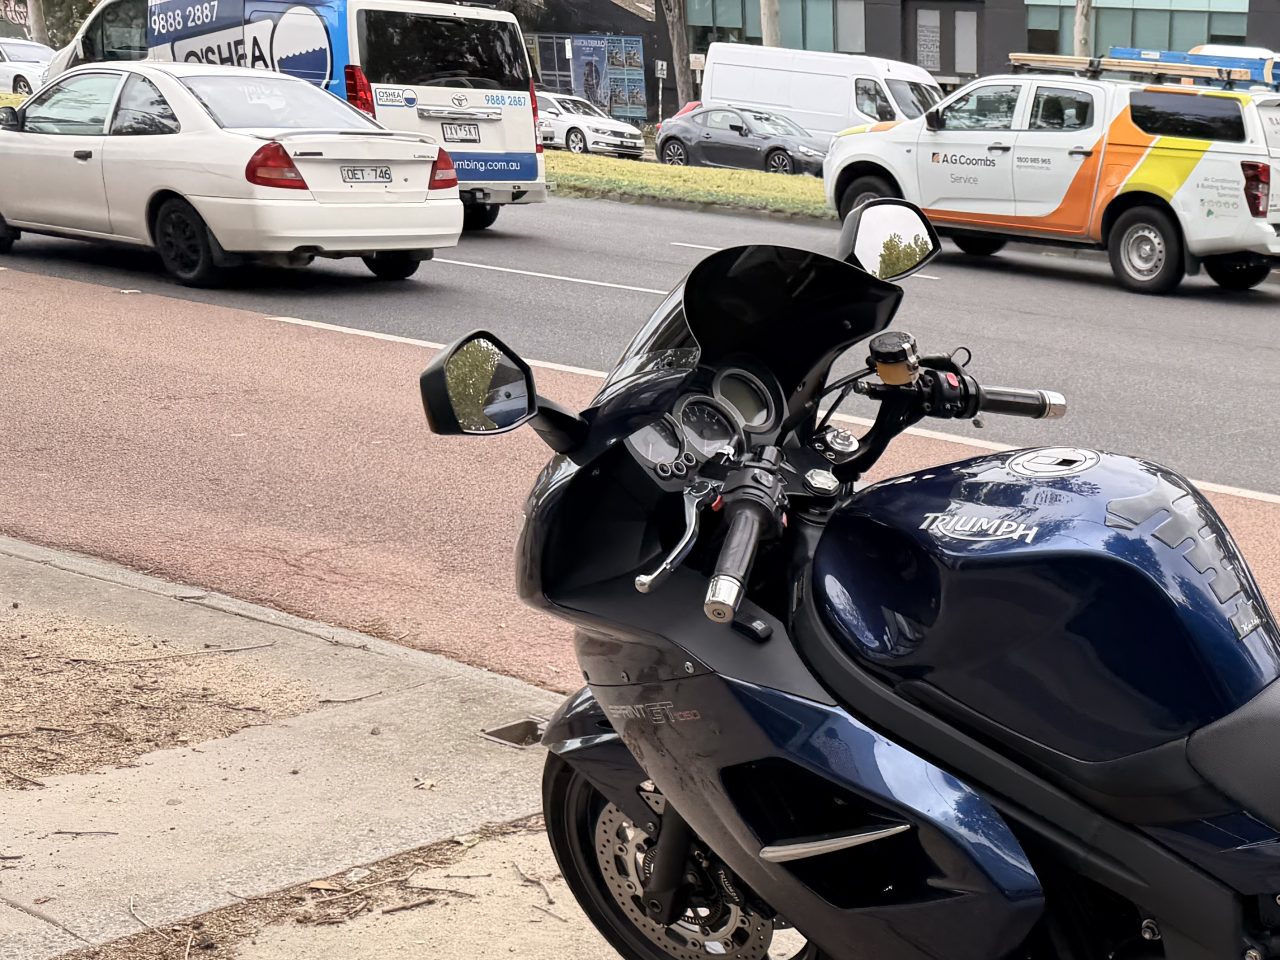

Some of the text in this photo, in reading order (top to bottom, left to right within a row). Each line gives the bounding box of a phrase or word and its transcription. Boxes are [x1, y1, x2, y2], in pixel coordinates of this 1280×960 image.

[151, 1, 218, 36] 9888 2887
[484, 94, 526, 107] 9888 2887
[958, 154, 996, 167] Coombs
[371, 168, 391, 180] 746
[950, 173, 979, 184] Service
[917, 512, 1038, 544] TRIUMPH
